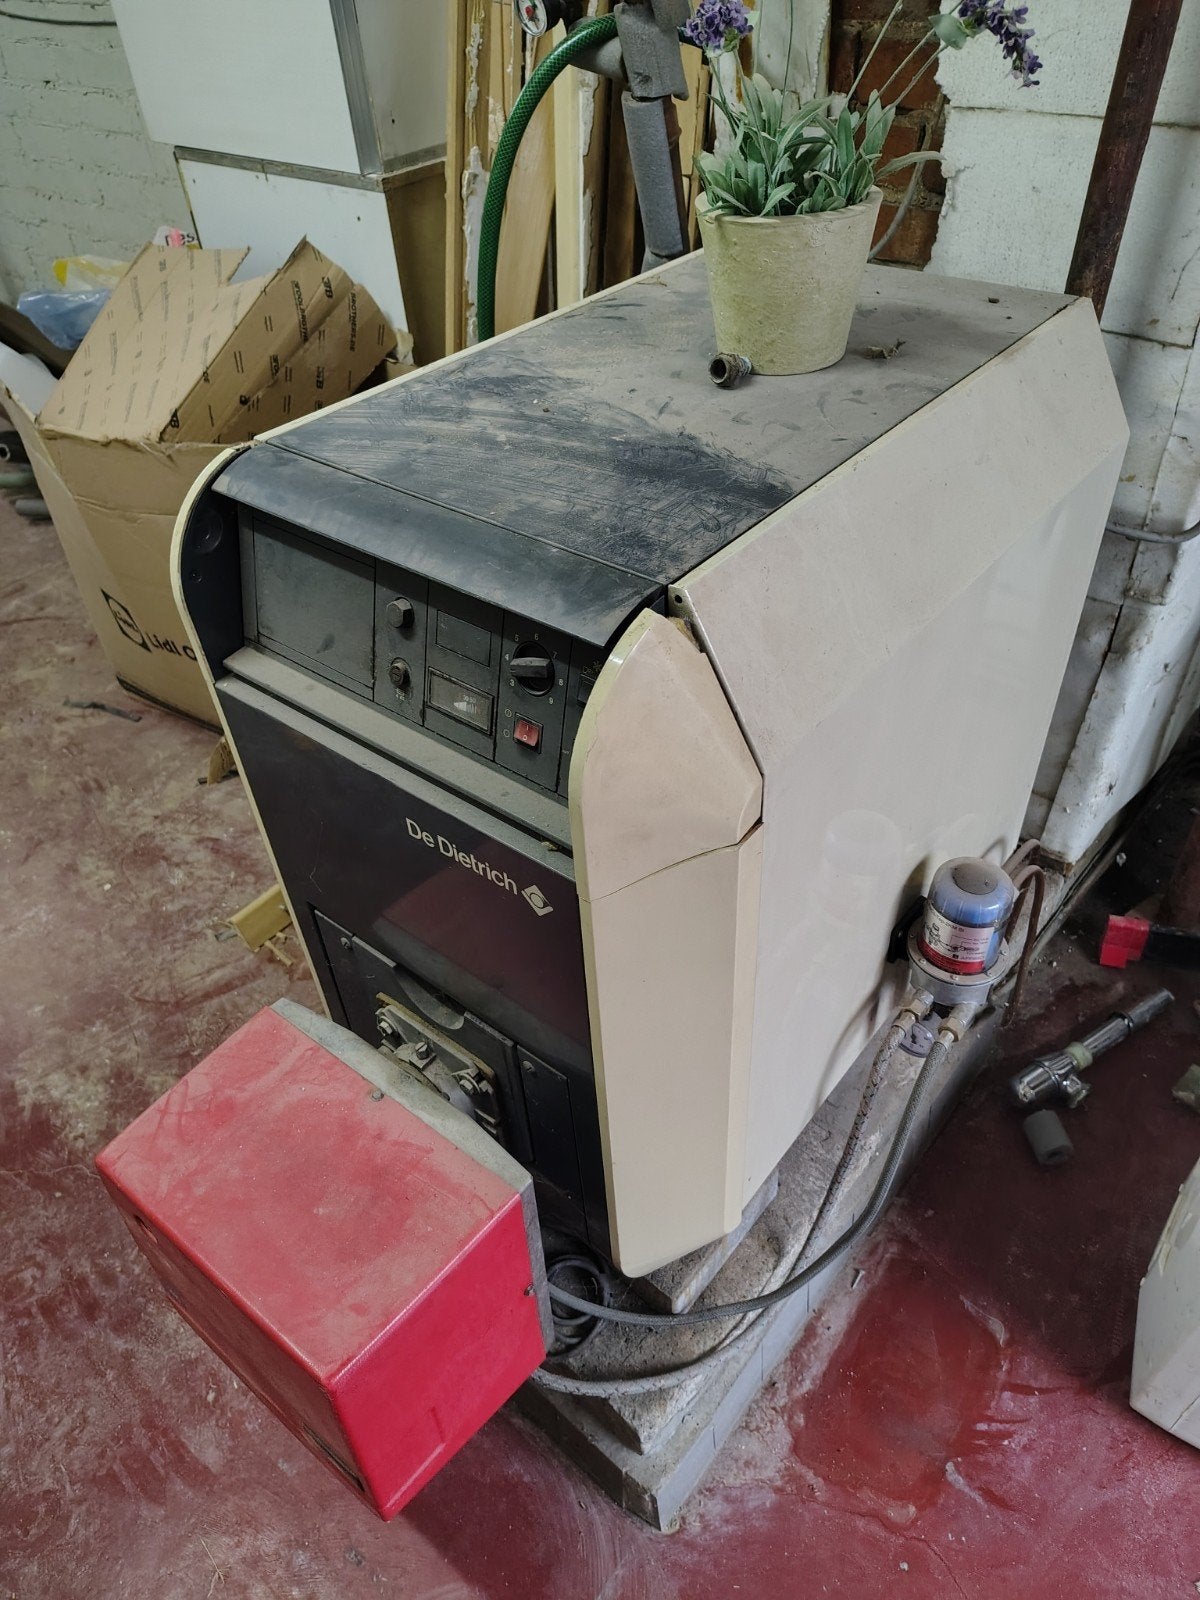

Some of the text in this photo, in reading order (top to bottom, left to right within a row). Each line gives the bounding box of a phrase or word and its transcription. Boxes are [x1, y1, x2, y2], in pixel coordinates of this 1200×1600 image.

[514, 634, 520, 642] 5
[534, 633, 539, 641] 6
[504, 653, 510, 661] 4
[509, 679, 515, 687] 3
[558, 679, 564, 687] 8
[548, 697, 554, 705] 9
[405, 817, 518, 895] De Dietrich
